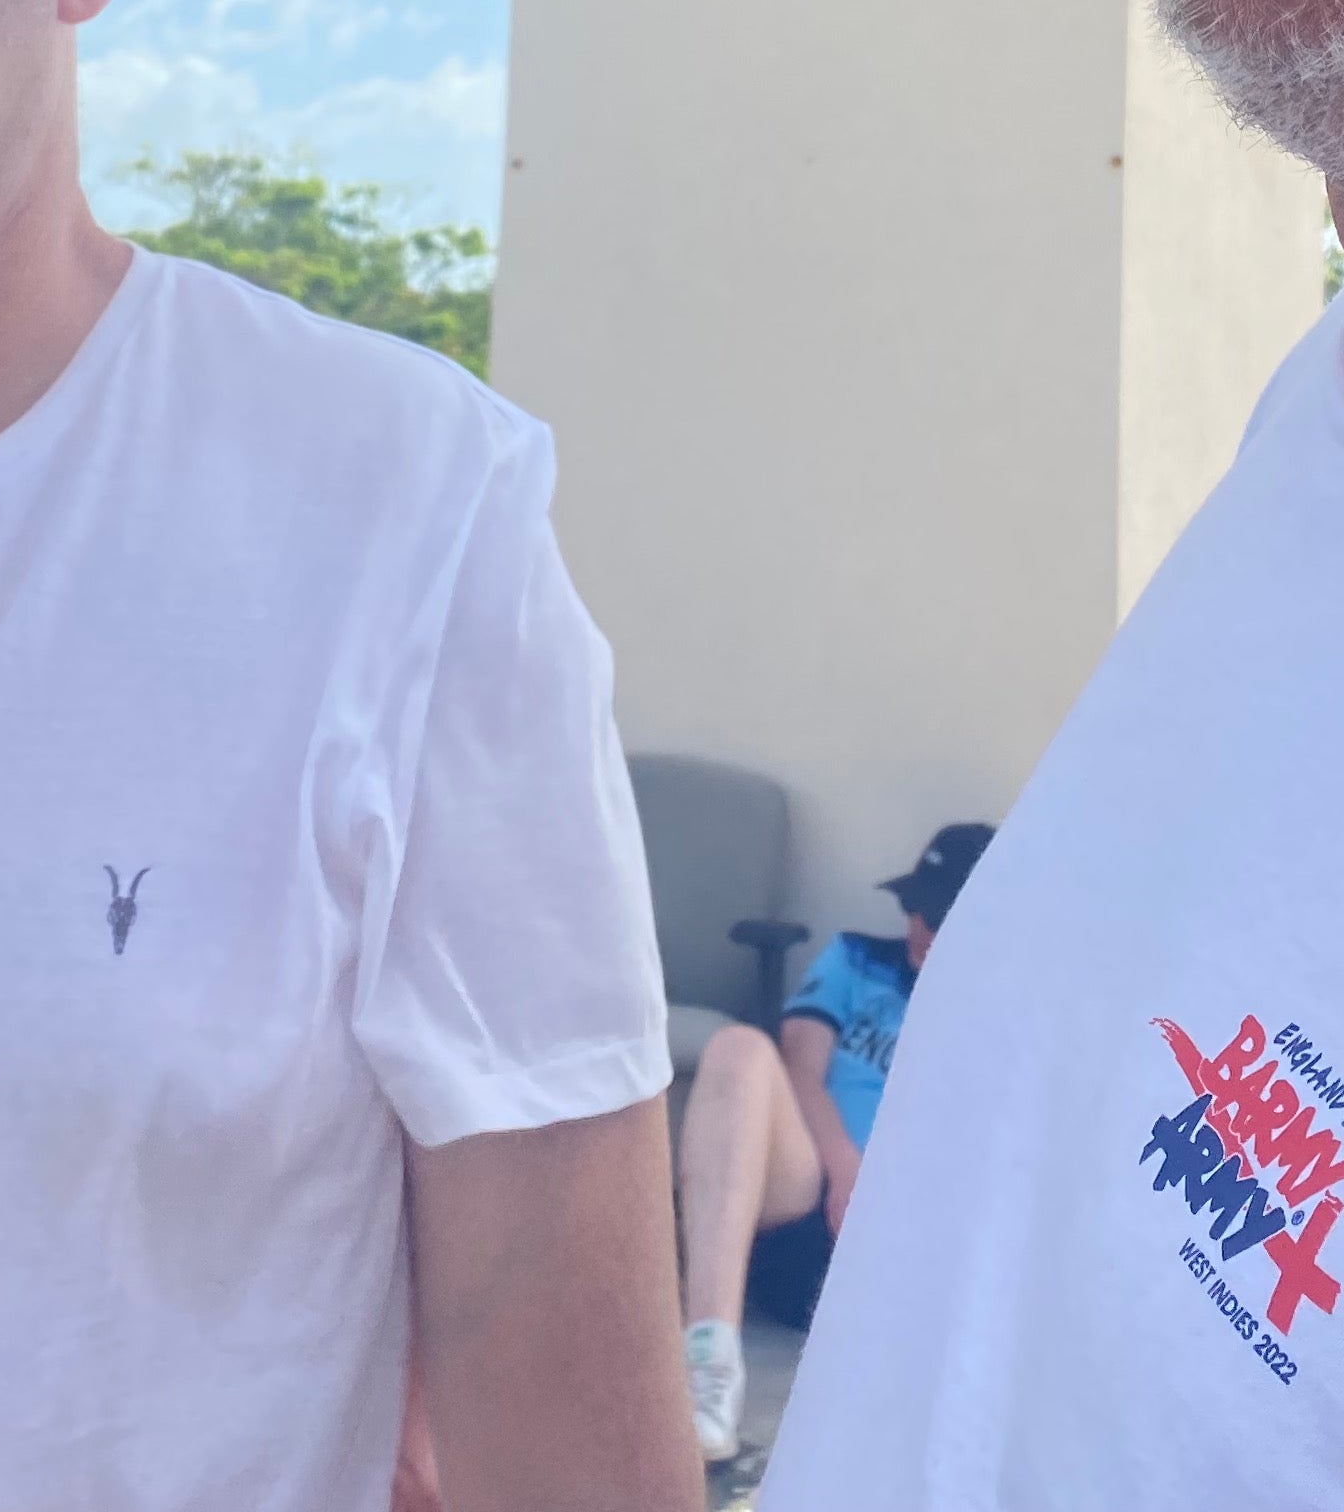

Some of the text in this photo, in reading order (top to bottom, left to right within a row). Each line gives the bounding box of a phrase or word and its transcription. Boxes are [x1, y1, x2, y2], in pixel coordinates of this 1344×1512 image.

[1139, 1094, 1287, 1261] ARMY
[1178, 1237, 1298, 1385] WEST INDIES 2022
